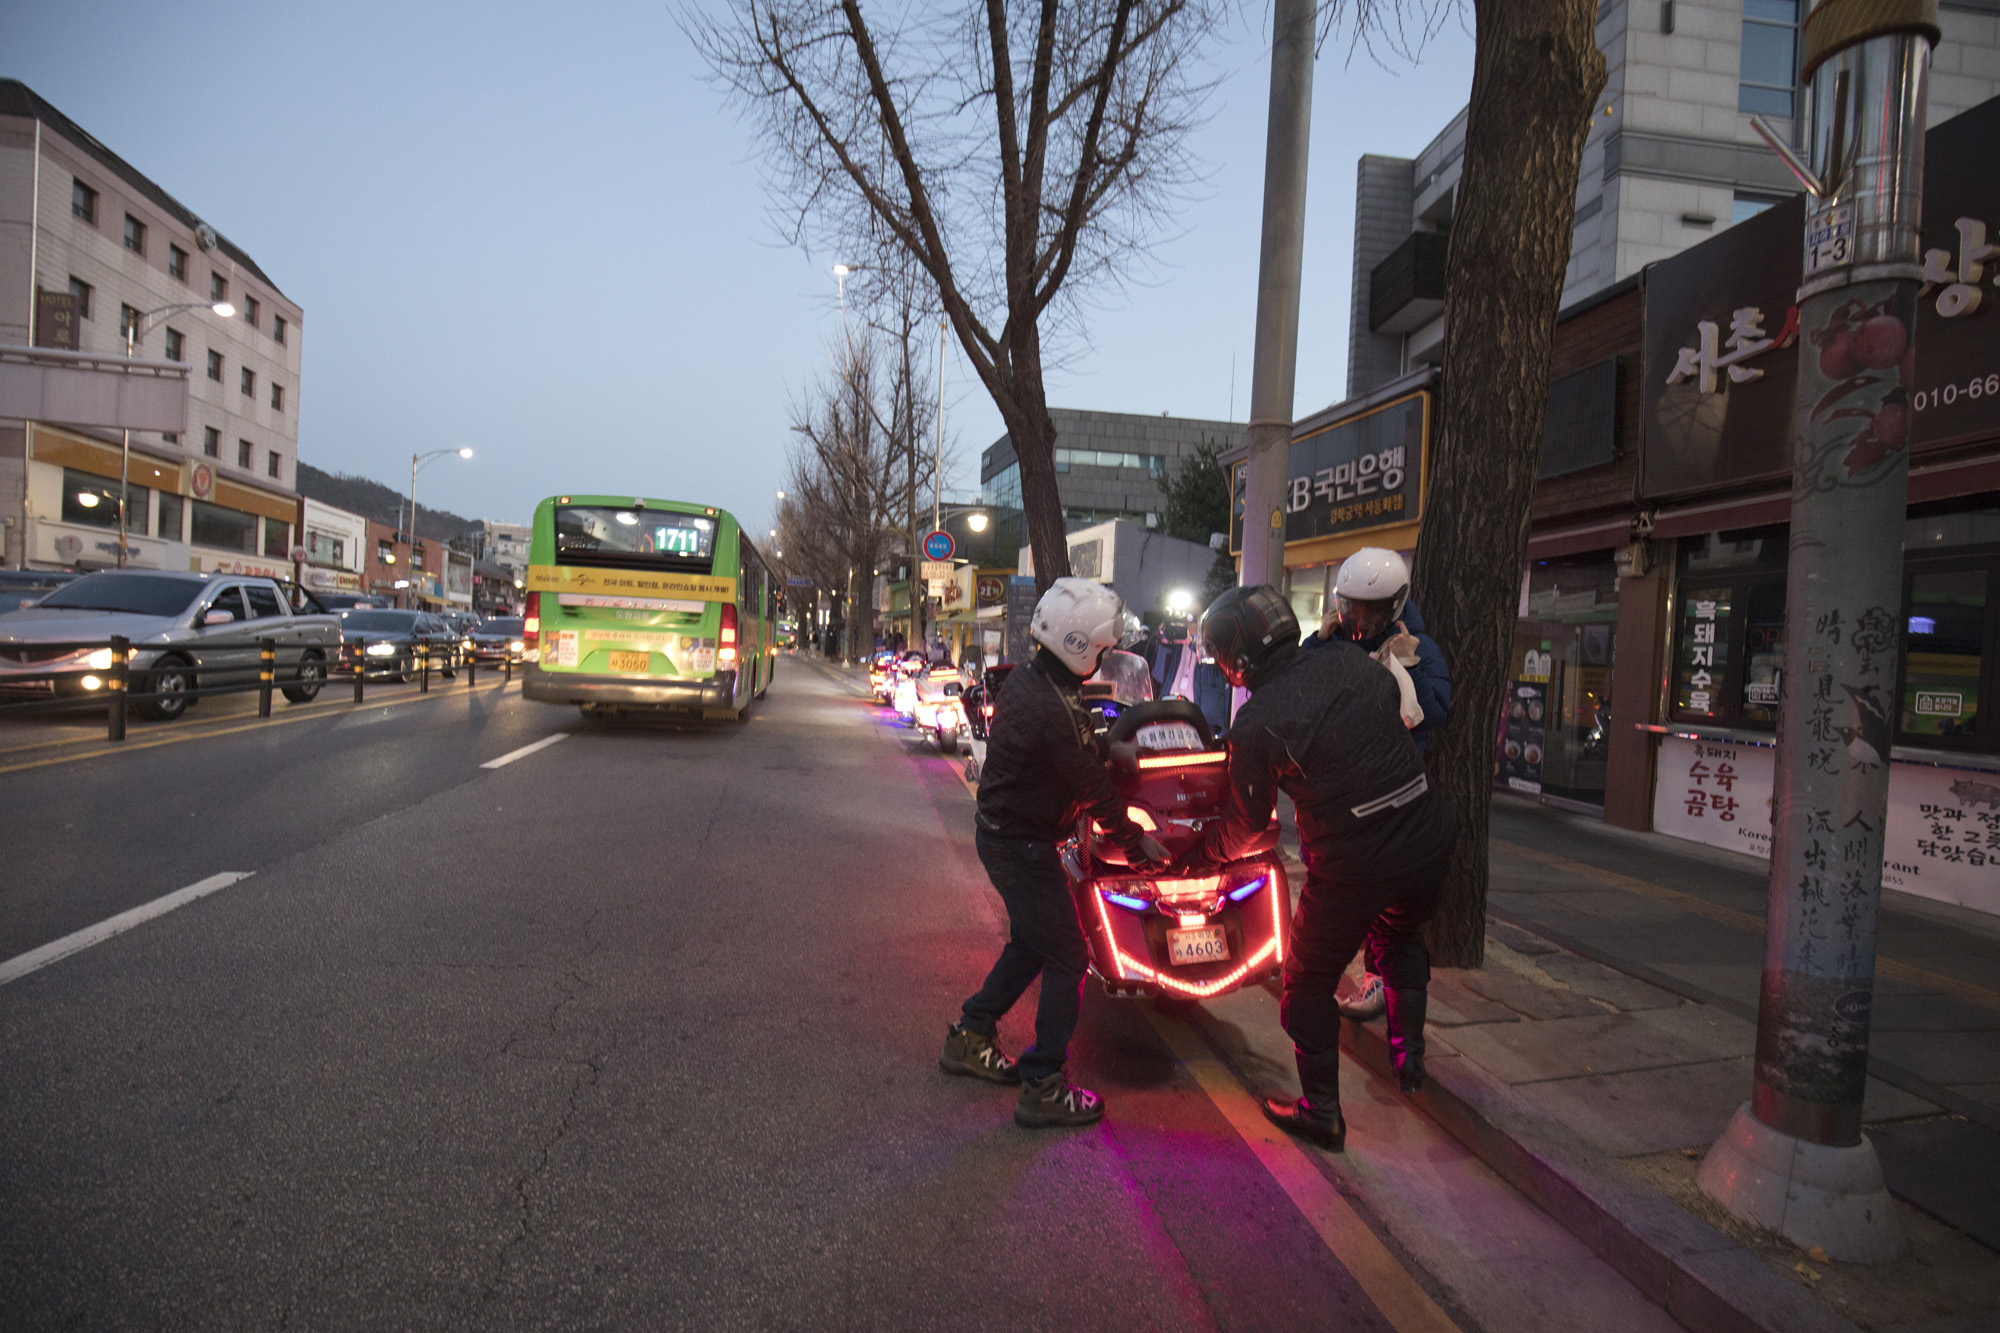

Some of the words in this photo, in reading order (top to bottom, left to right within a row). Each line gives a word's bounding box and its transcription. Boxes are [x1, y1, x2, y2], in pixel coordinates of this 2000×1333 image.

[1811, 238, 1847, 268] 1-3
[40, 294, 72, 307] MOTEL
[656, 528, 697, 552] 1711
[1690, 600, 1716, 712] 흑돼지수육
[1694, 743, 1737, 760] 흑돼지
[1689, 760, 1738, 792] 수육
[1684, 788, 1740, 822] 곰탕
[1920, 804, 1966, 821] 맛과
[1931, 822, 1954, 841] 한
[1186, 940, 1223, 956] 4603
